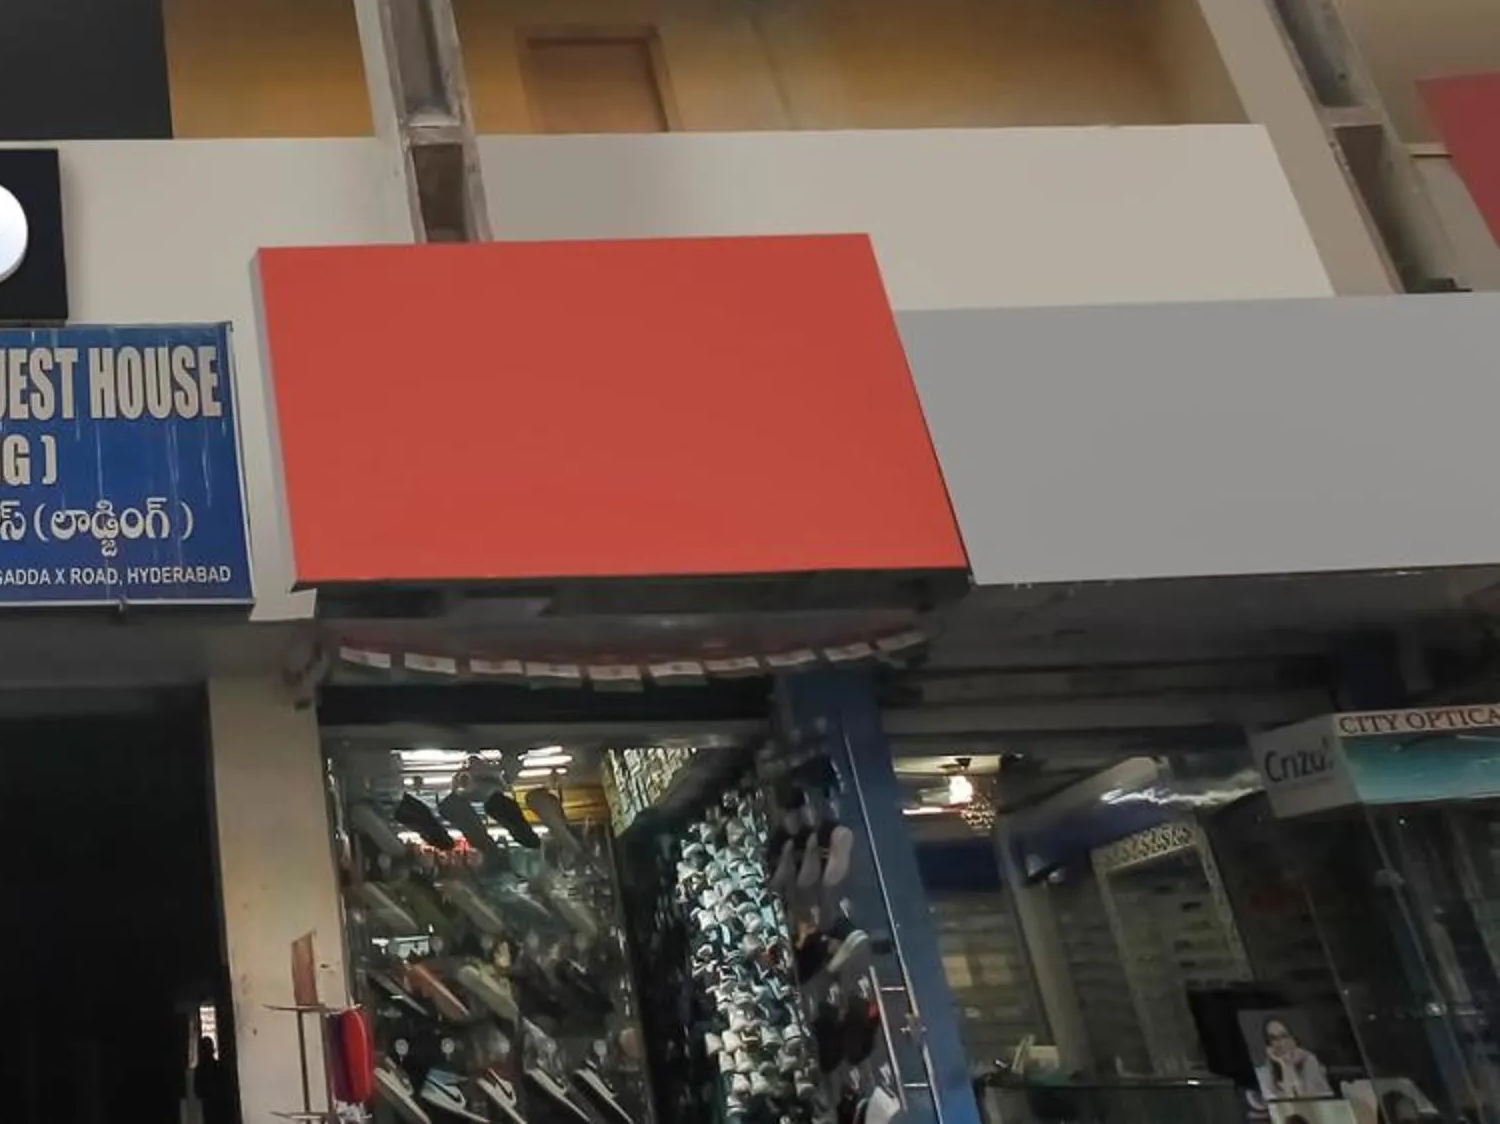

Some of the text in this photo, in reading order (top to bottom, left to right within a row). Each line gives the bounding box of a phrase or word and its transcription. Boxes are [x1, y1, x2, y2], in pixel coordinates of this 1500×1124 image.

[88, 344, 223, 420] HOUSE
[54, 570, 66, 585] X
[70, 568, 123, 587] ROAD,
[127, 566, 231, 584] HYDERABAD
[1339, 714, 1400, 734] CITY
